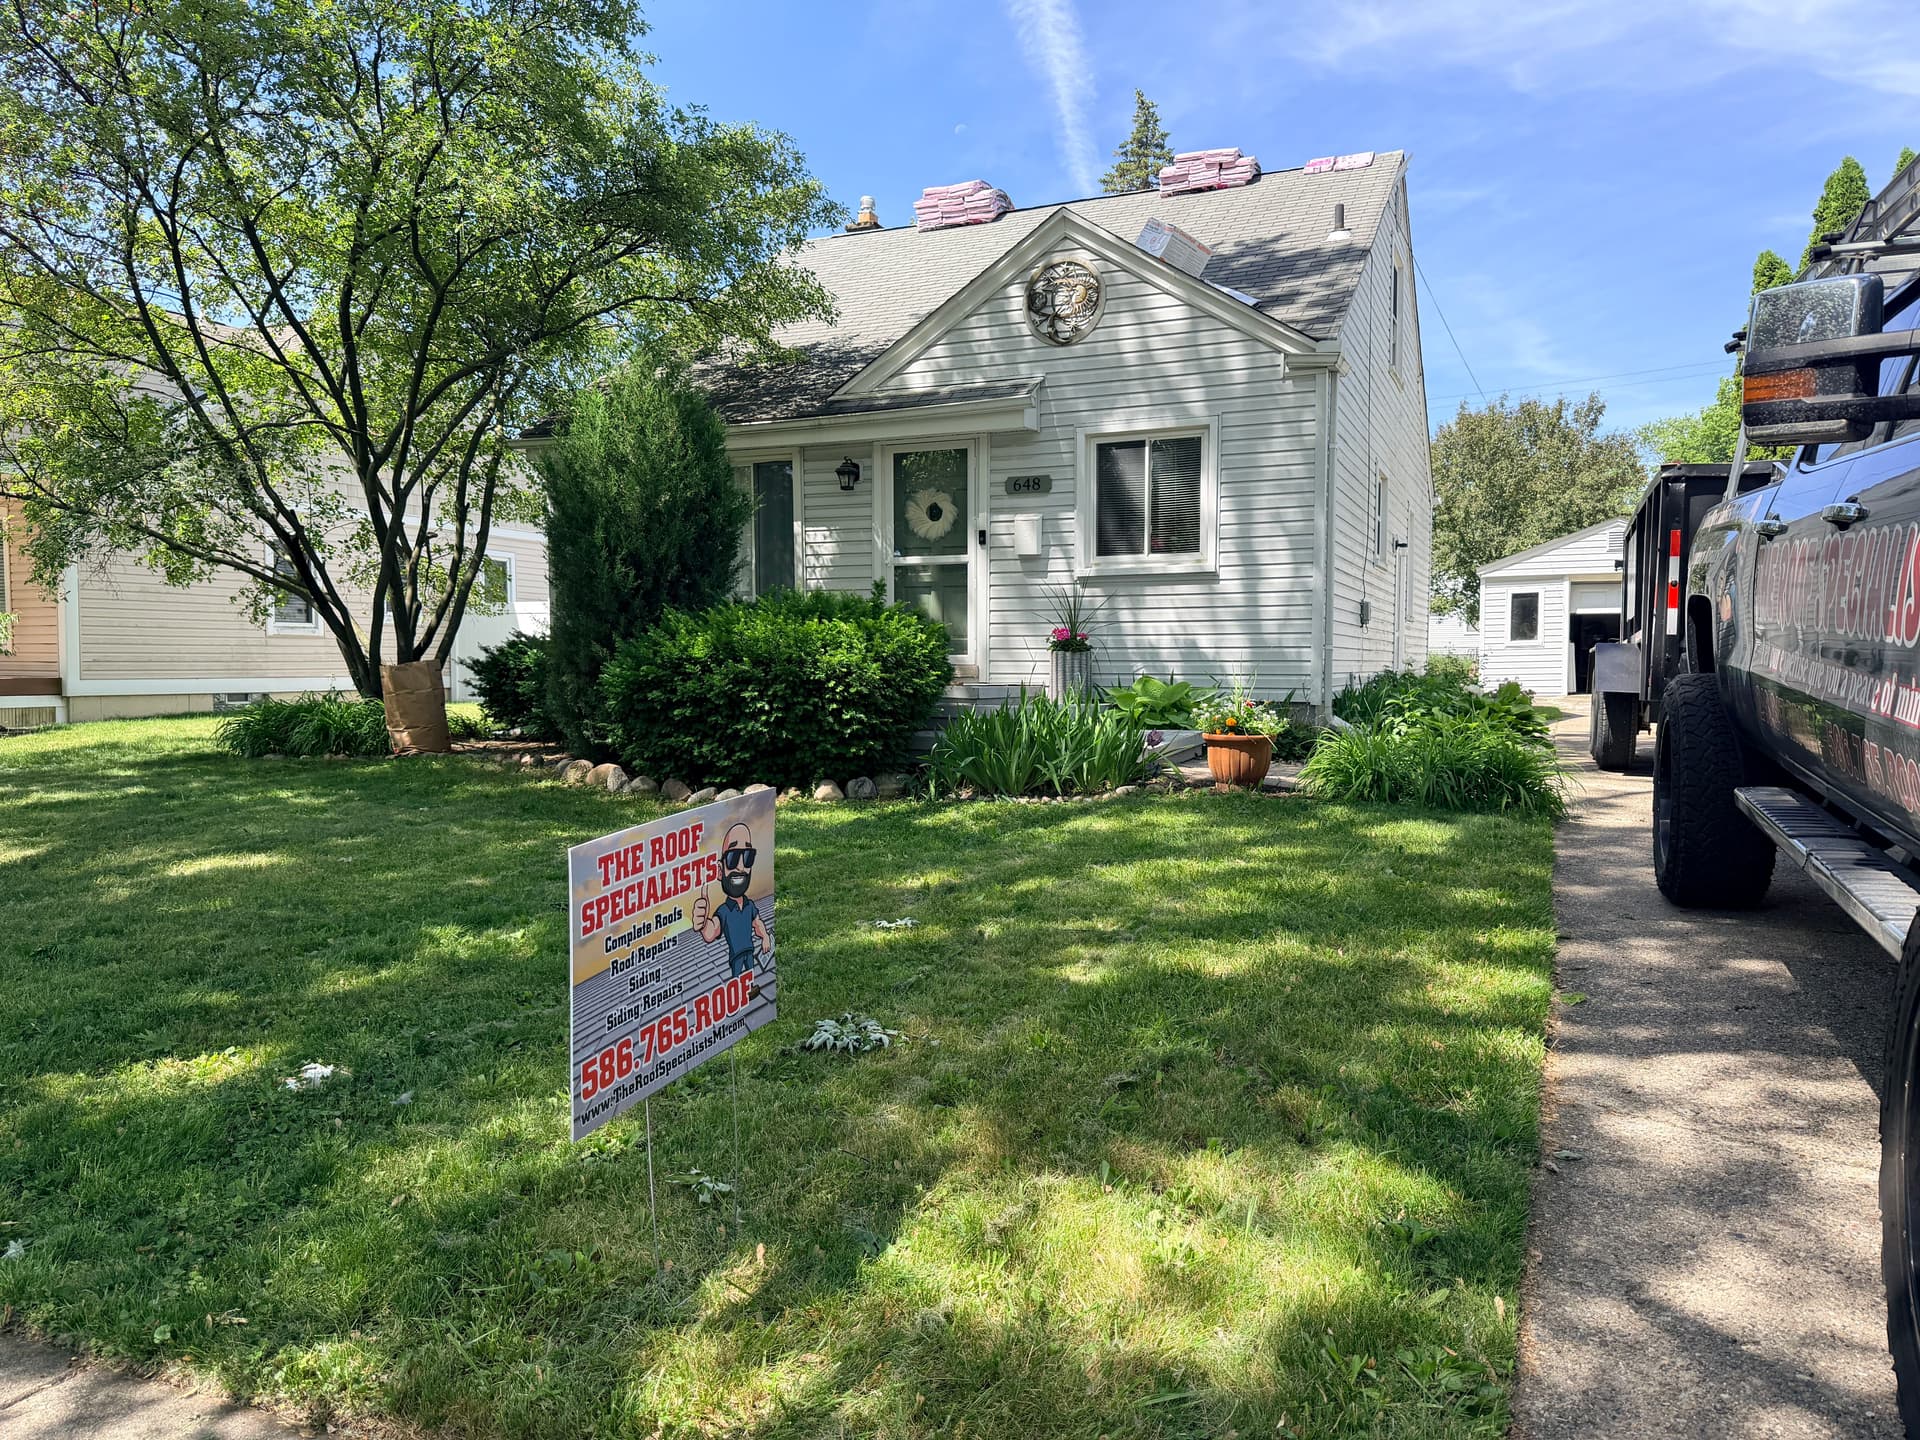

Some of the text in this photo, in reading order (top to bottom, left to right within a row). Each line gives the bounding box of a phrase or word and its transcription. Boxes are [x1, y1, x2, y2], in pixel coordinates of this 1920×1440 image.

[1013, 477, 1041, 491] 648
[1820, 663, 1842, 701] you
[1839, 669, 1849, 698] a
[1846, 671, 1881, 711] peace
[1880, 671, 1898, 717] of
[597, 822, 704, 888] THE ROOF
[581, 853, 718, 937] SPECIALISTS
[604, 906, 683, 954] Complete Roofs
[610, 935, 679, 977] Roof Repairs
[606, 981, 684, 1032] Siding Repairs
[629, 967, 662, 994] Siding
[581, 970, 754, 1101] 586.765.ROOF
[580, 1017, 746, 1126] www.TheRoofSpecialistsMI.com
